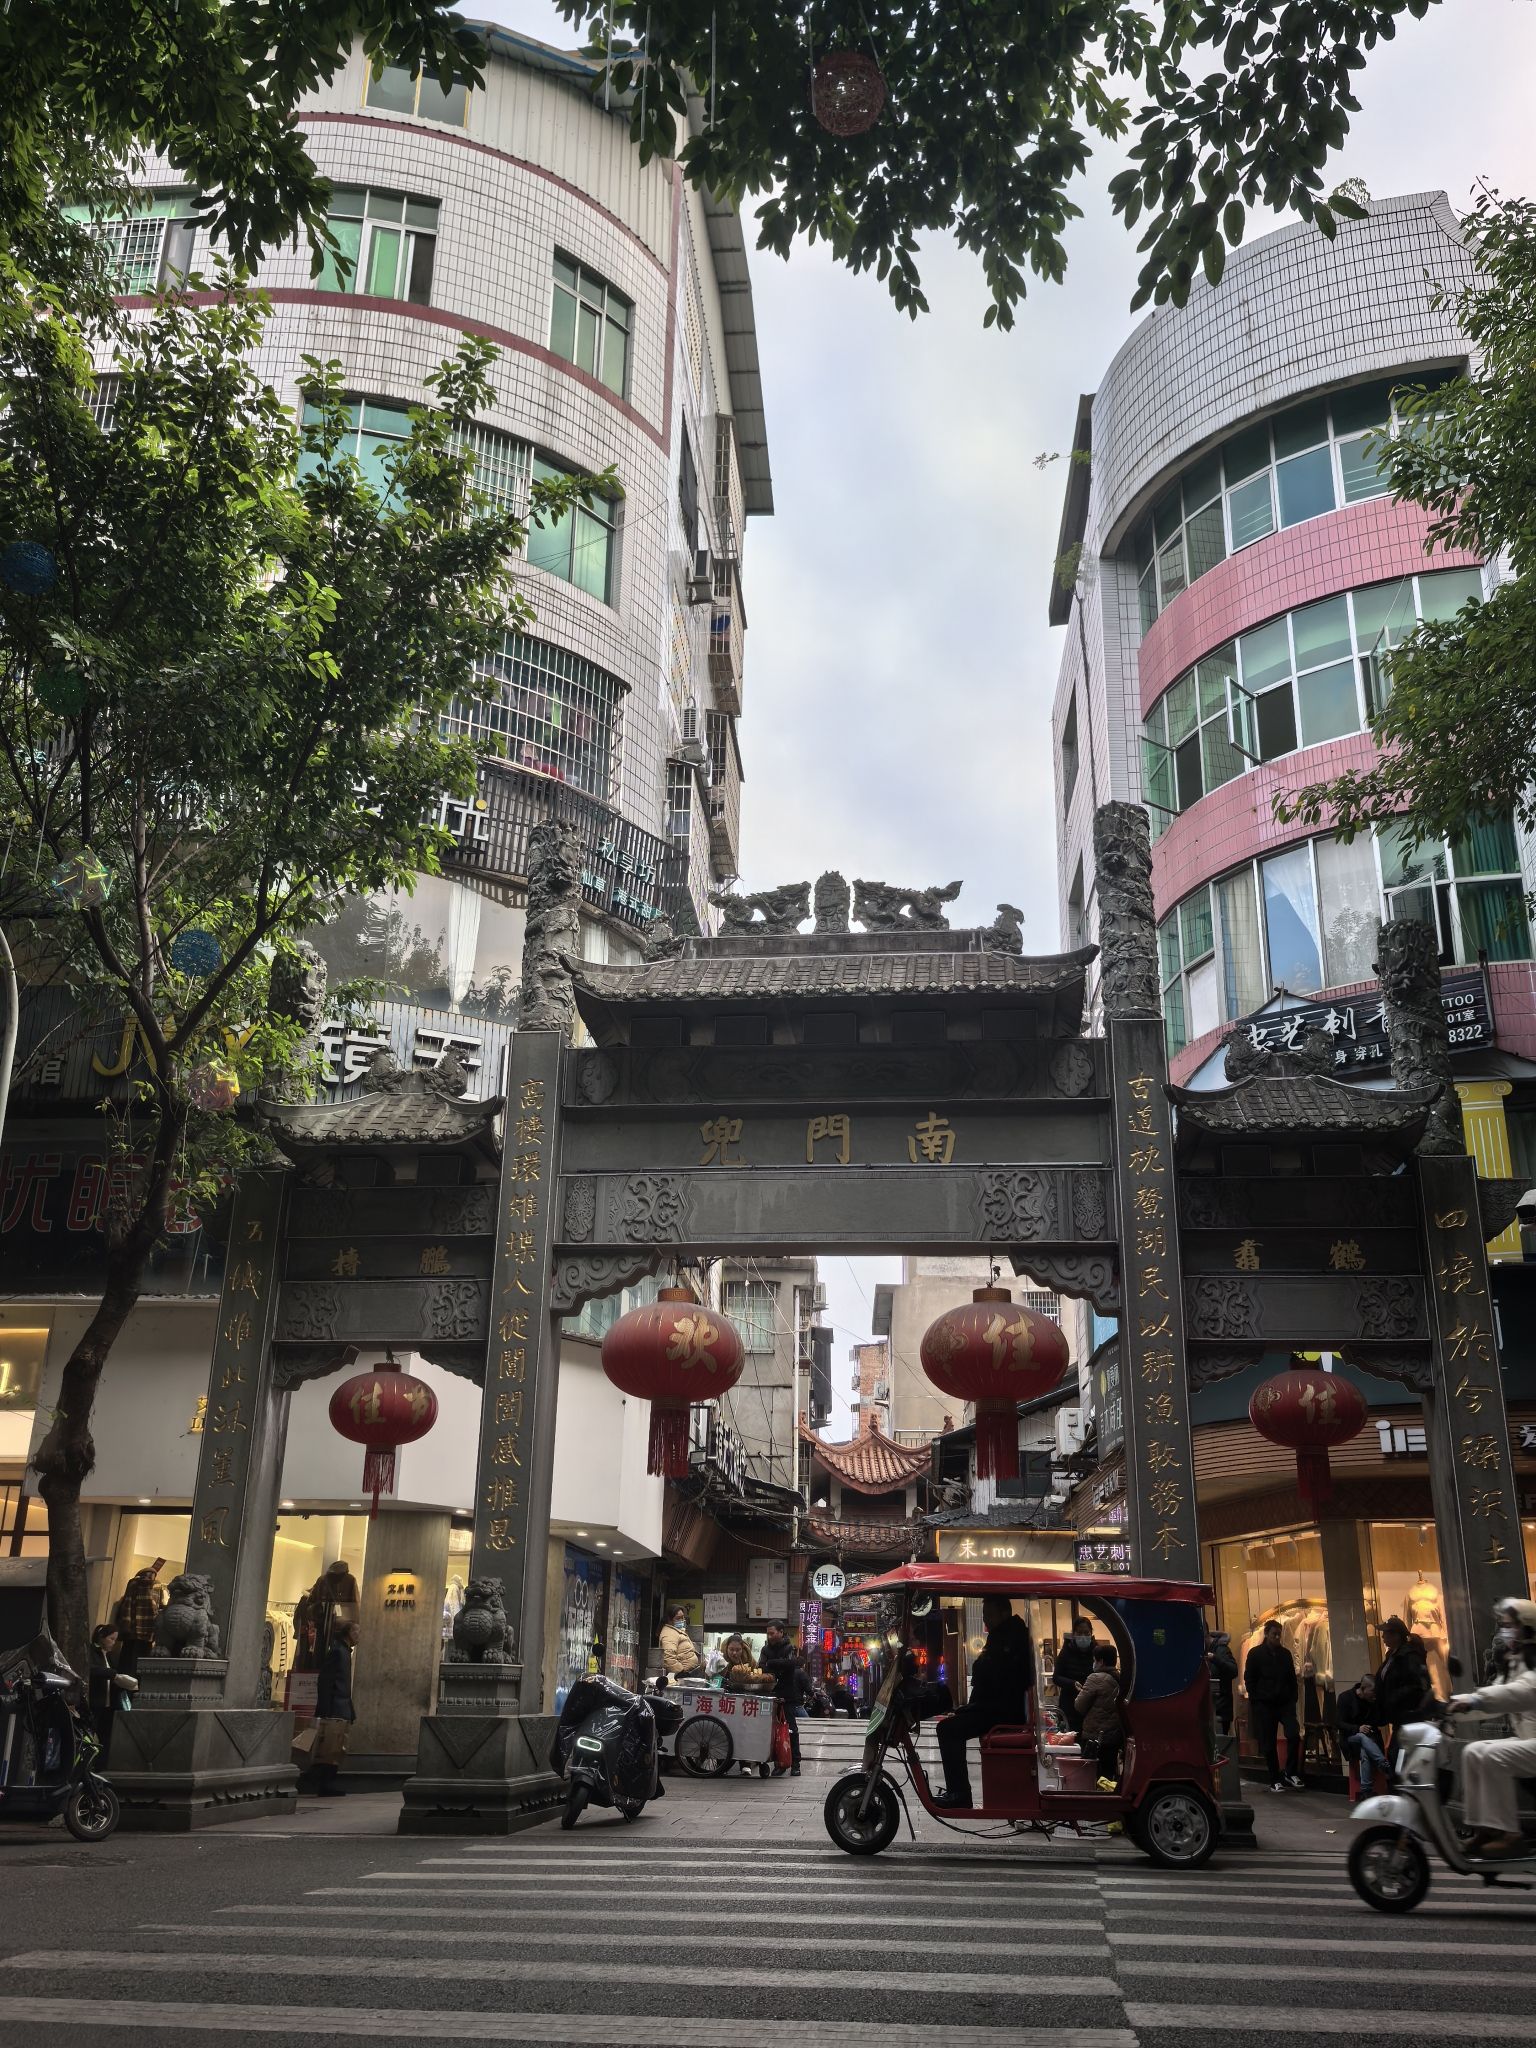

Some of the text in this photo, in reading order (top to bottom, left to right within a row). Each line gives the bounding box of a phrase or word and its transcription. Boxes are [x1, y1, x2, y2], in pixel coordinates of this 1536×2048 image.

[597, 836, 657, 885] 私享坊
[816, 1573, 844, 1587] 银店
[696, 1695, 760, 1718] 海蛎饼
